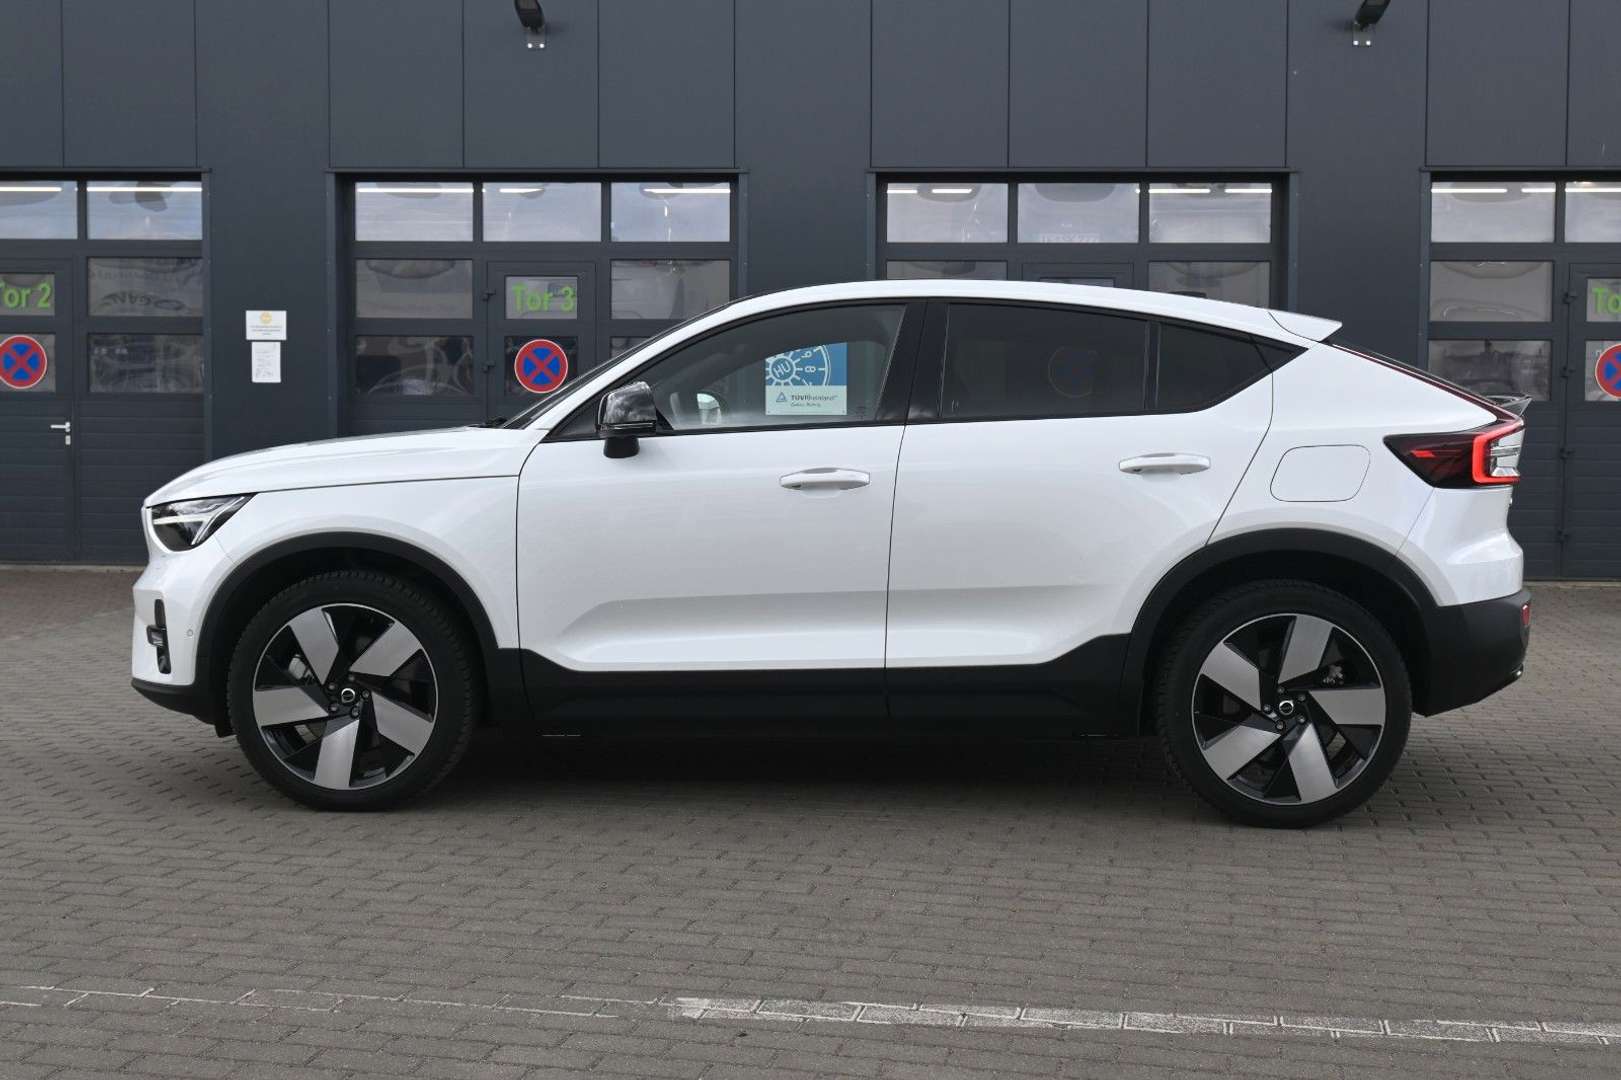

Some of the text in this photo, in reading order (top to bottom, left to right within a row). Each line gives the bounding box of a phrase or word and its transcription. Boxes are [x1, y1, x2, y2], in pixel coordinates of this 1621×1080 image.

[37, 283, 51, 308] 2
[512, 283, 574, 312] Tor 3
[773, 360, 791, 378] HU
[804, 365, 817, 373] 8
